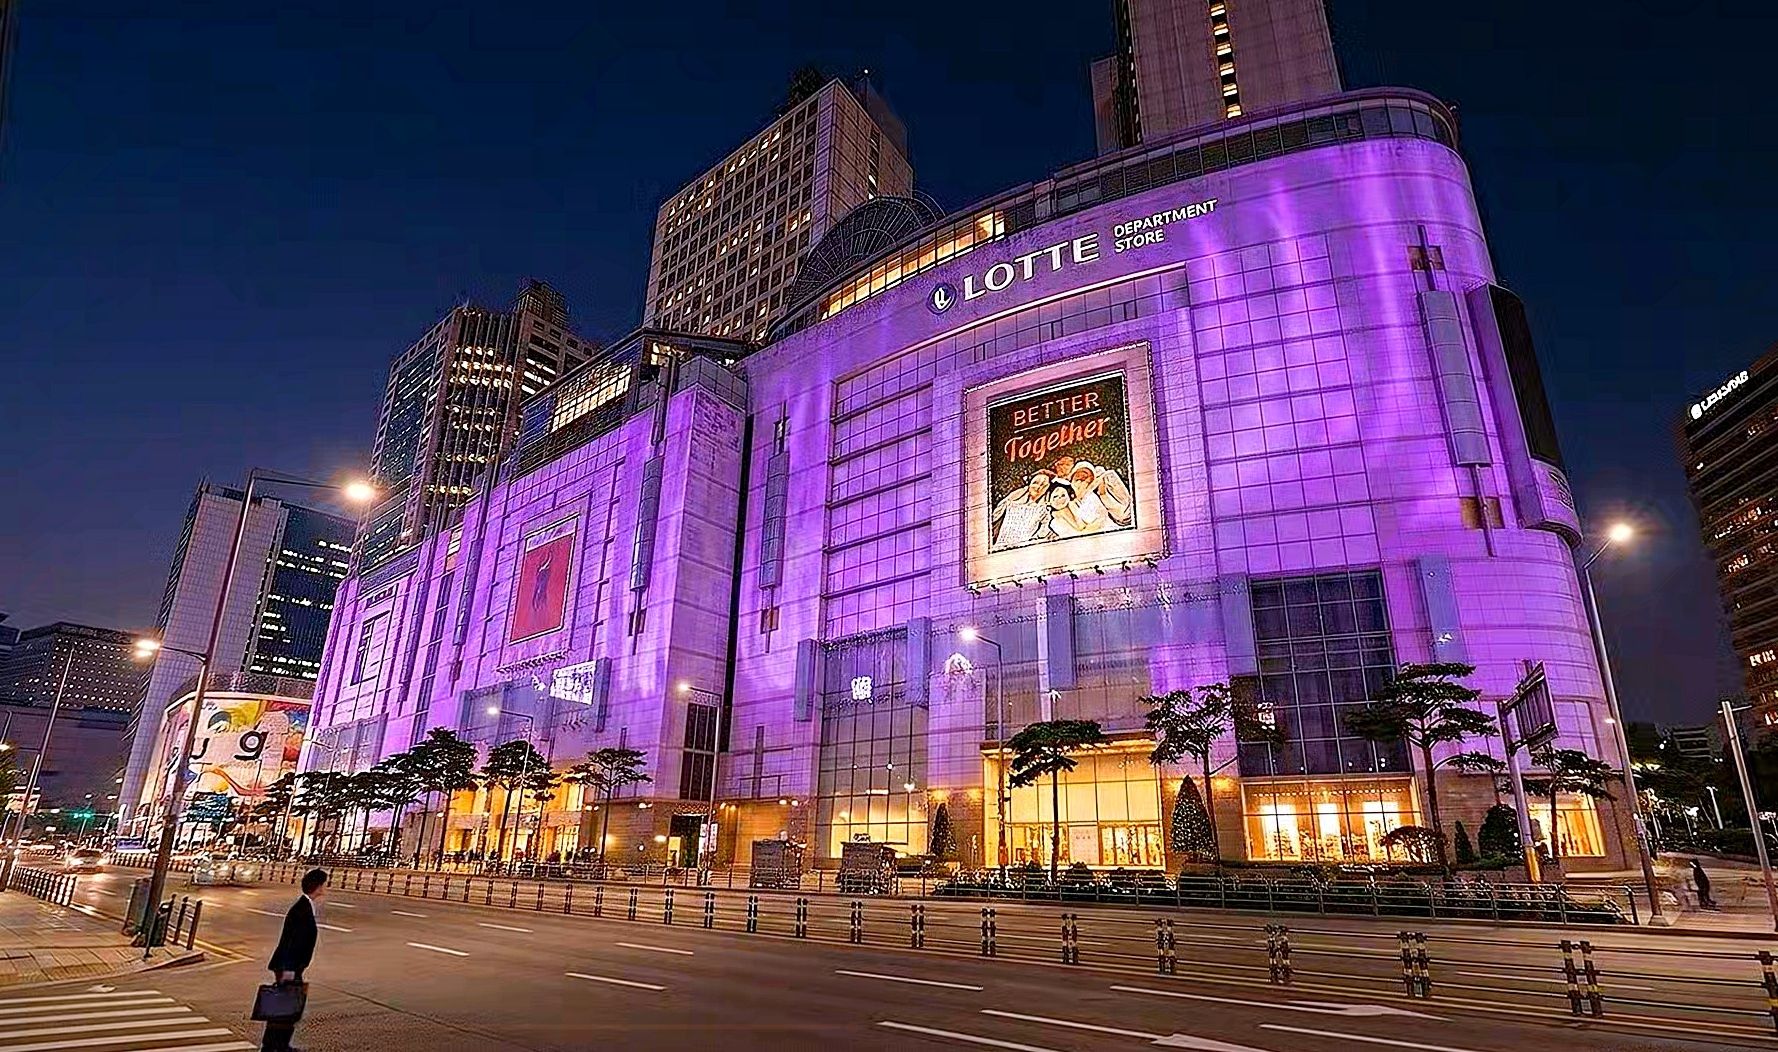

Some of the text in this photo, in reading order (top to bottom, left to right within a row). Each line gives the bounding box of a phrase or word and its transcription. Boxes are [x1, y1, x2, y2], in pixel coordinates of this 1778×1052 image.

[1113, 199, 1218, 238] DEPARTMENT
[1114, 230, 1165, 253] STORE
[963, 233, 1099, 301] LOTTE
[1014, 392, 1100, 427] BETTER
[1004, 414, 1110, 462] Together
